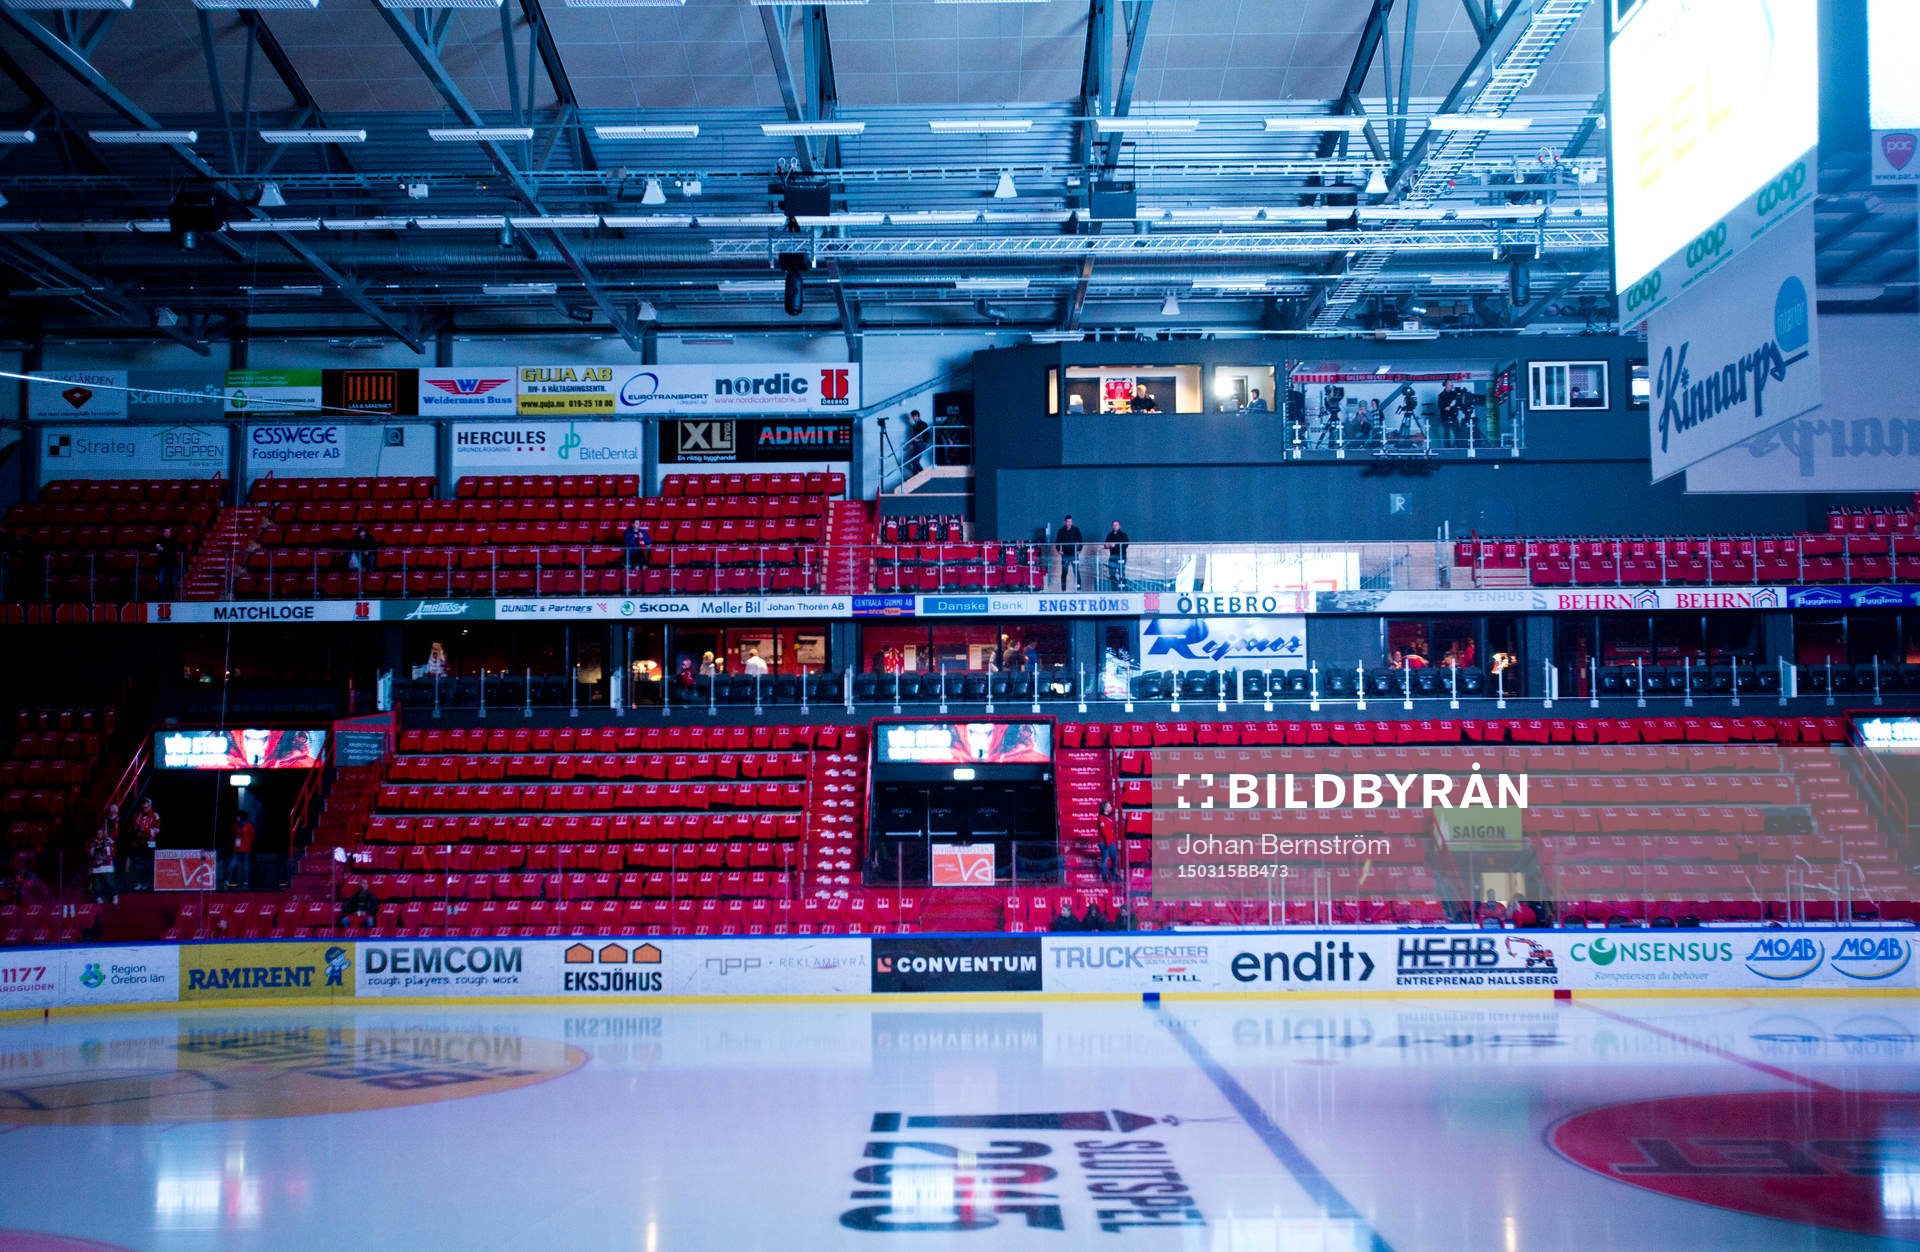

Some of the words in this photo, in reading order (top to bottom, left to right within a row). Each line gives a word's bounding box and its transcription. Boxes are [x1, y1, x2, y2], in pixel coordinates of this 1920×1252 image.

[1757, 162, 1807, 217] coop
[1686, 221, 1728, 269] coop
[1626, 270, 1662, 312] coop
[521, 367, 578, 382] GUJA
[581, 367, 613, 382] AB
[715, 373, 808, 395] nordic
[487, 396, 512, 404] Buss
[1656, 339, 1792, 453] Kinnarps
[166, 432, 200, 445] BYGG
[253, 426, 337, 445] ESSWEGE
[457, 431, 546, 445] HERCULES
[682, 422, 731, 449] XL
[758, 426, 838, 445] ADMIT
[76, 438, 136, 457] Strateg
[253, 448, 320, 462] Fastigheter
[323, 448, 340, 459] AB
[579, 447, 638, 460] BiteDental
[1039, 596, 1129, 612] ENGSTRÖMS
[1177, 593, 1277, 613] ÖREBRO
[1463, 591, 1524, 602] STENHUS
[1557, 593, 1633, 609] BEHRN
[1676, 592, 1751, 608] BEHRN
[214, 606, 314, 620] MATCHLOGE
[548, 604, 593, 613] Partners
[701, 602, 741, 613] Møller
[745, 601, 760, 613] Bil
[768, 602, 795, 611] Johan
[797, 602, 829, 611] Thorén
[831, 602, 845, 610] AB
[937, 601, 985, 610] Danske
[992, 600, 1024, 610] Bank
[1453, 825, 1506, 841] SAIGON
[1570, 937, 1733, 966] CONSENSUS
[1745, 937, 1818, 961] MOAB
[1831, 937, 1905, 961] MOAB
[366, 947, 522, 974] DEMCOM
[779, 954, 866, 968] REKLAMBYRÅ
[897, 956, 1037, 973] CONVENTUM
[1050, 946, 1144, 969] TRUCK
[1142, 946, 1208, 956] CENTER
[1231, 940, 1354, 982] endit
[2, 966, 46, 983] 1177
[111, 963, 146, 975] Region
[111, 972, 147, 984] Örebro
[150, 973, 165, 984] län
[188, 967, 315, 990] RAMIRENT
[368, 976, 400, 987] rough
[405, 975, 449, 988] players
[455, 975, 489, 986] rough
[493, 975, 519, 984] work
[564, 967, 662, 992] EKSJÖHUS
[1152, 974, 1201, 982] STILL
[1397, 976, 1483, 985] ENTREPRENAD
[1488, 975, 1559, 985] HALLSBERG
